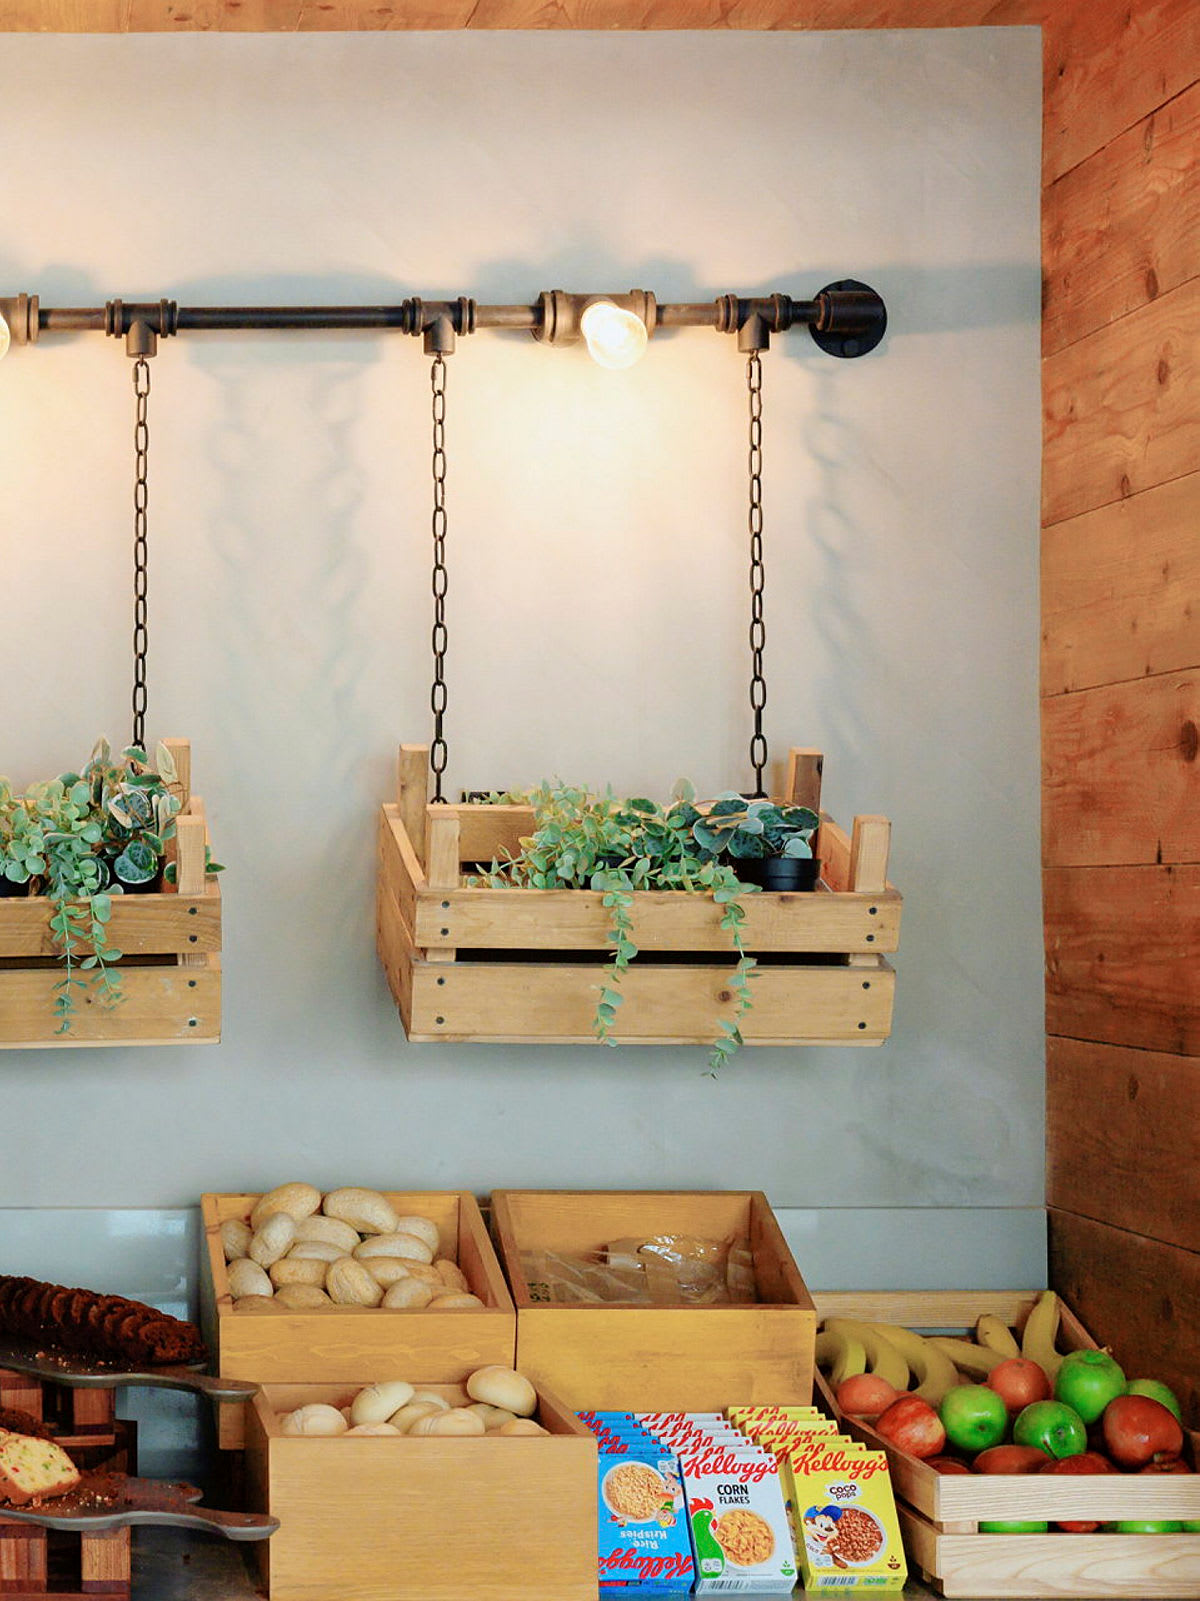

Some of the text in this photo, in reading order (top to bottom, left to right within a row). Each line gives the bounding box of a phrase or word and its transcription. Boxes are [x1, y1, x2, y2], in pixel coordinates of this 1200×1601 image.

[683, 1452, 778, 1483] Kellogg's
[792, 1450, 889, 1480] Kellogg's
[716, 1484, 749, 1496] CORN
[719, 1496, 751, 1505] FLAKES
[620, 1529, 668, 1541] Krispies
[632, 1539, 660, 1550] Rice
